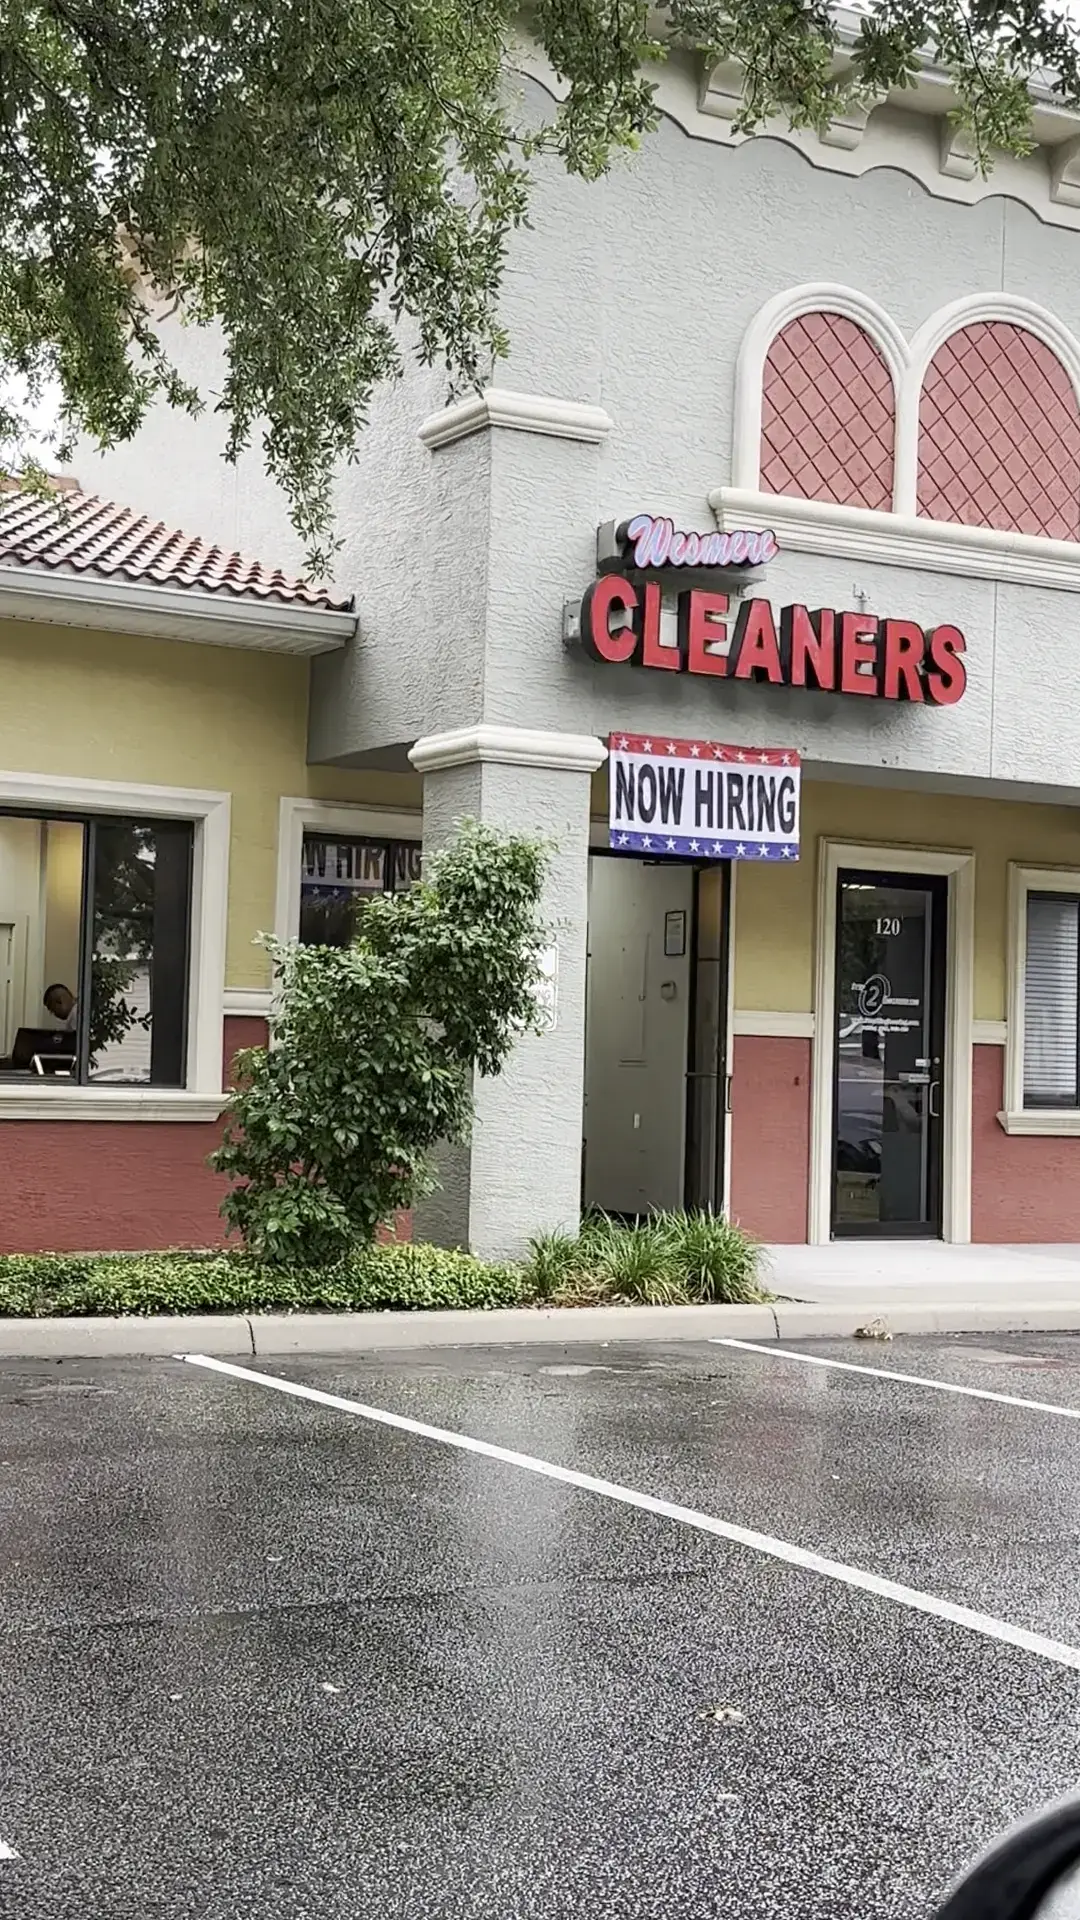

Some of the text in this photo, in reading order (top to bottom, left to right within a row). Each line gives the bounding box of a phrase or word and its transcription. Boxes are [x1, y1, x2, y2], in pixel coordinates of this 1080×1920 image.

[627, 514, 779, 568] Wesmere
[589, 573, 967, 706] CLEANERS
[615, 761, 796, 834] NOW HIRING
[336, 844, 422, 881] HIRNG
[876, 918, 900, 936] 120
